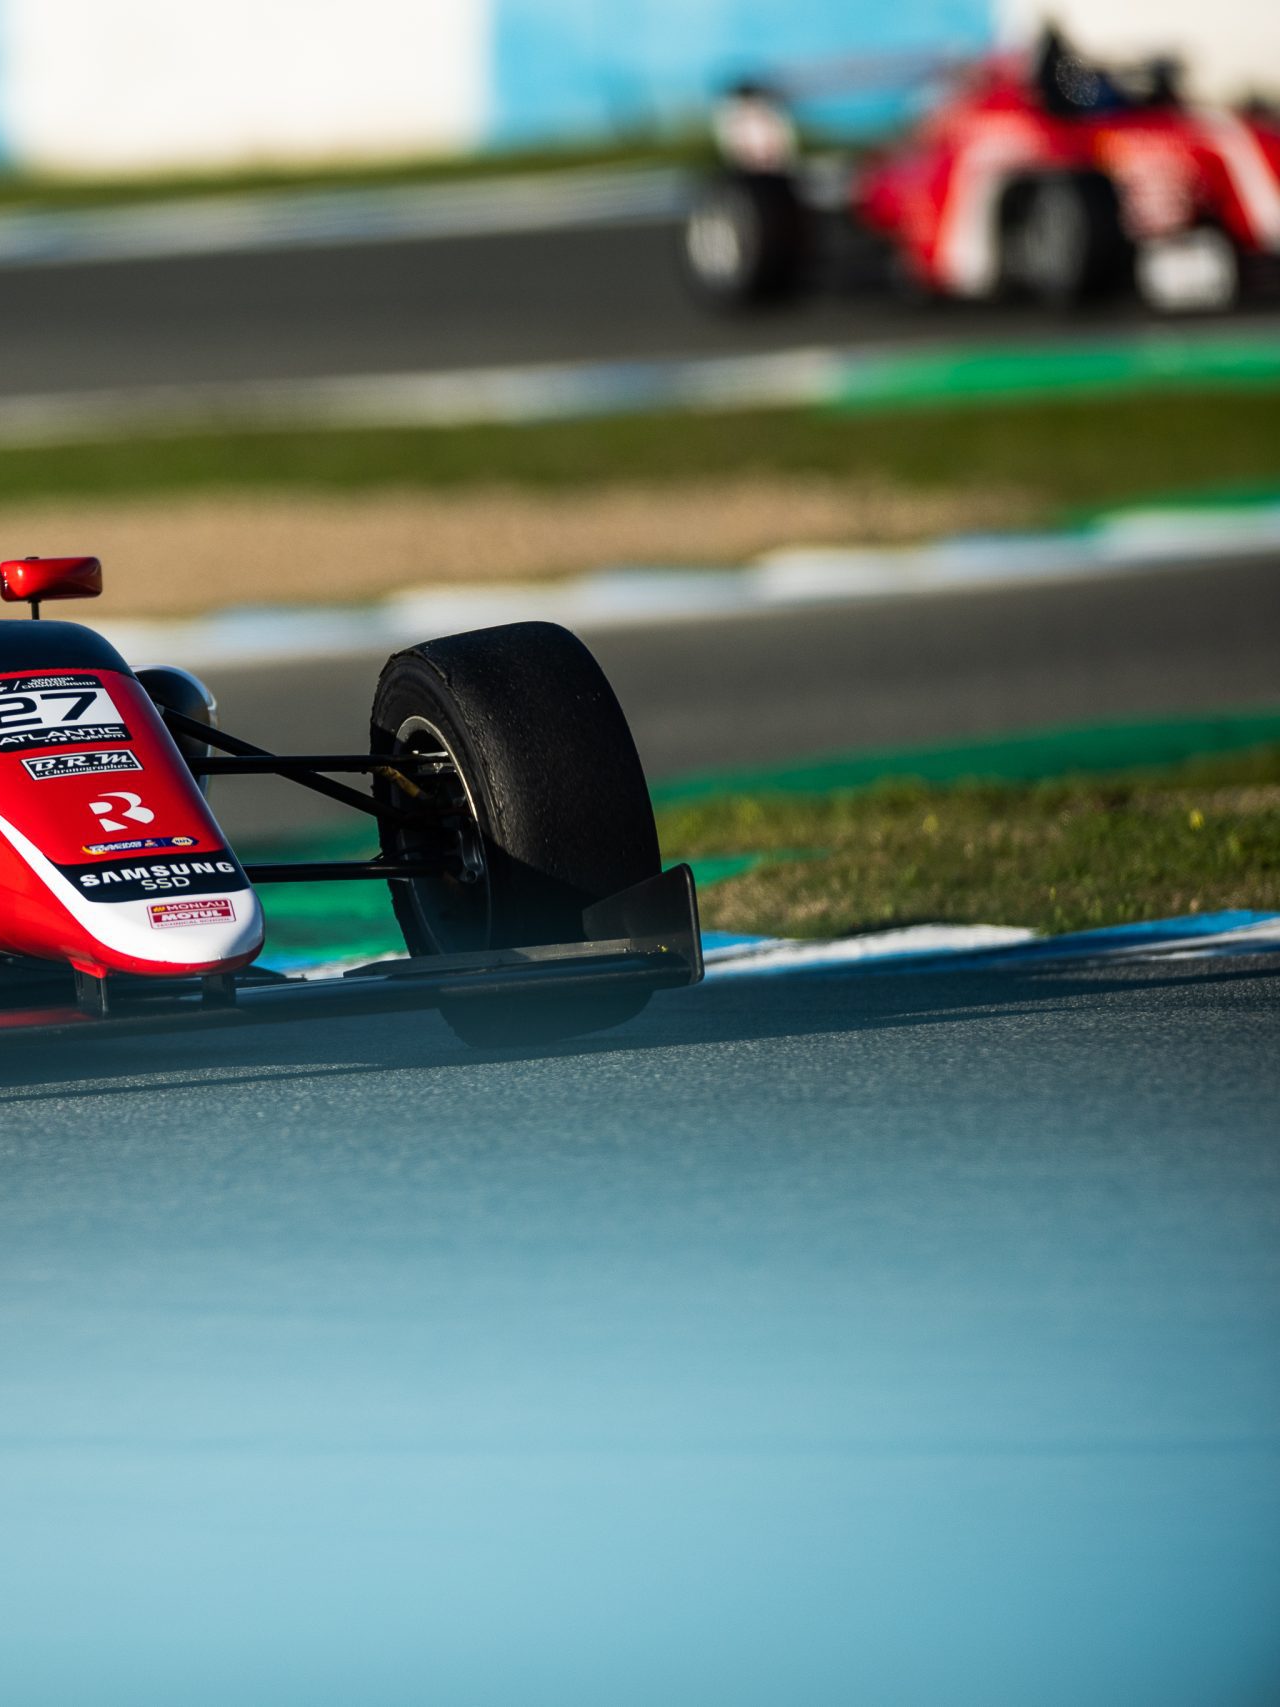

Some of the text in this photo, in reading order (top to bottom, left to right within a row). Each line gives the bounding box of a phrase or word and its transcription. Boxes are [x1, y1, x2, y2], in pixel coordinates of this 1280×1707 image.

[0, 726, 123, 746] ATLANTIC
[79, 862, 236, 888] SAMSUNG
[141, 876, 191, 891] SSD
[166, 900, 226, 912] MONLAU
[161, 910, 223, 922] MOTUL
